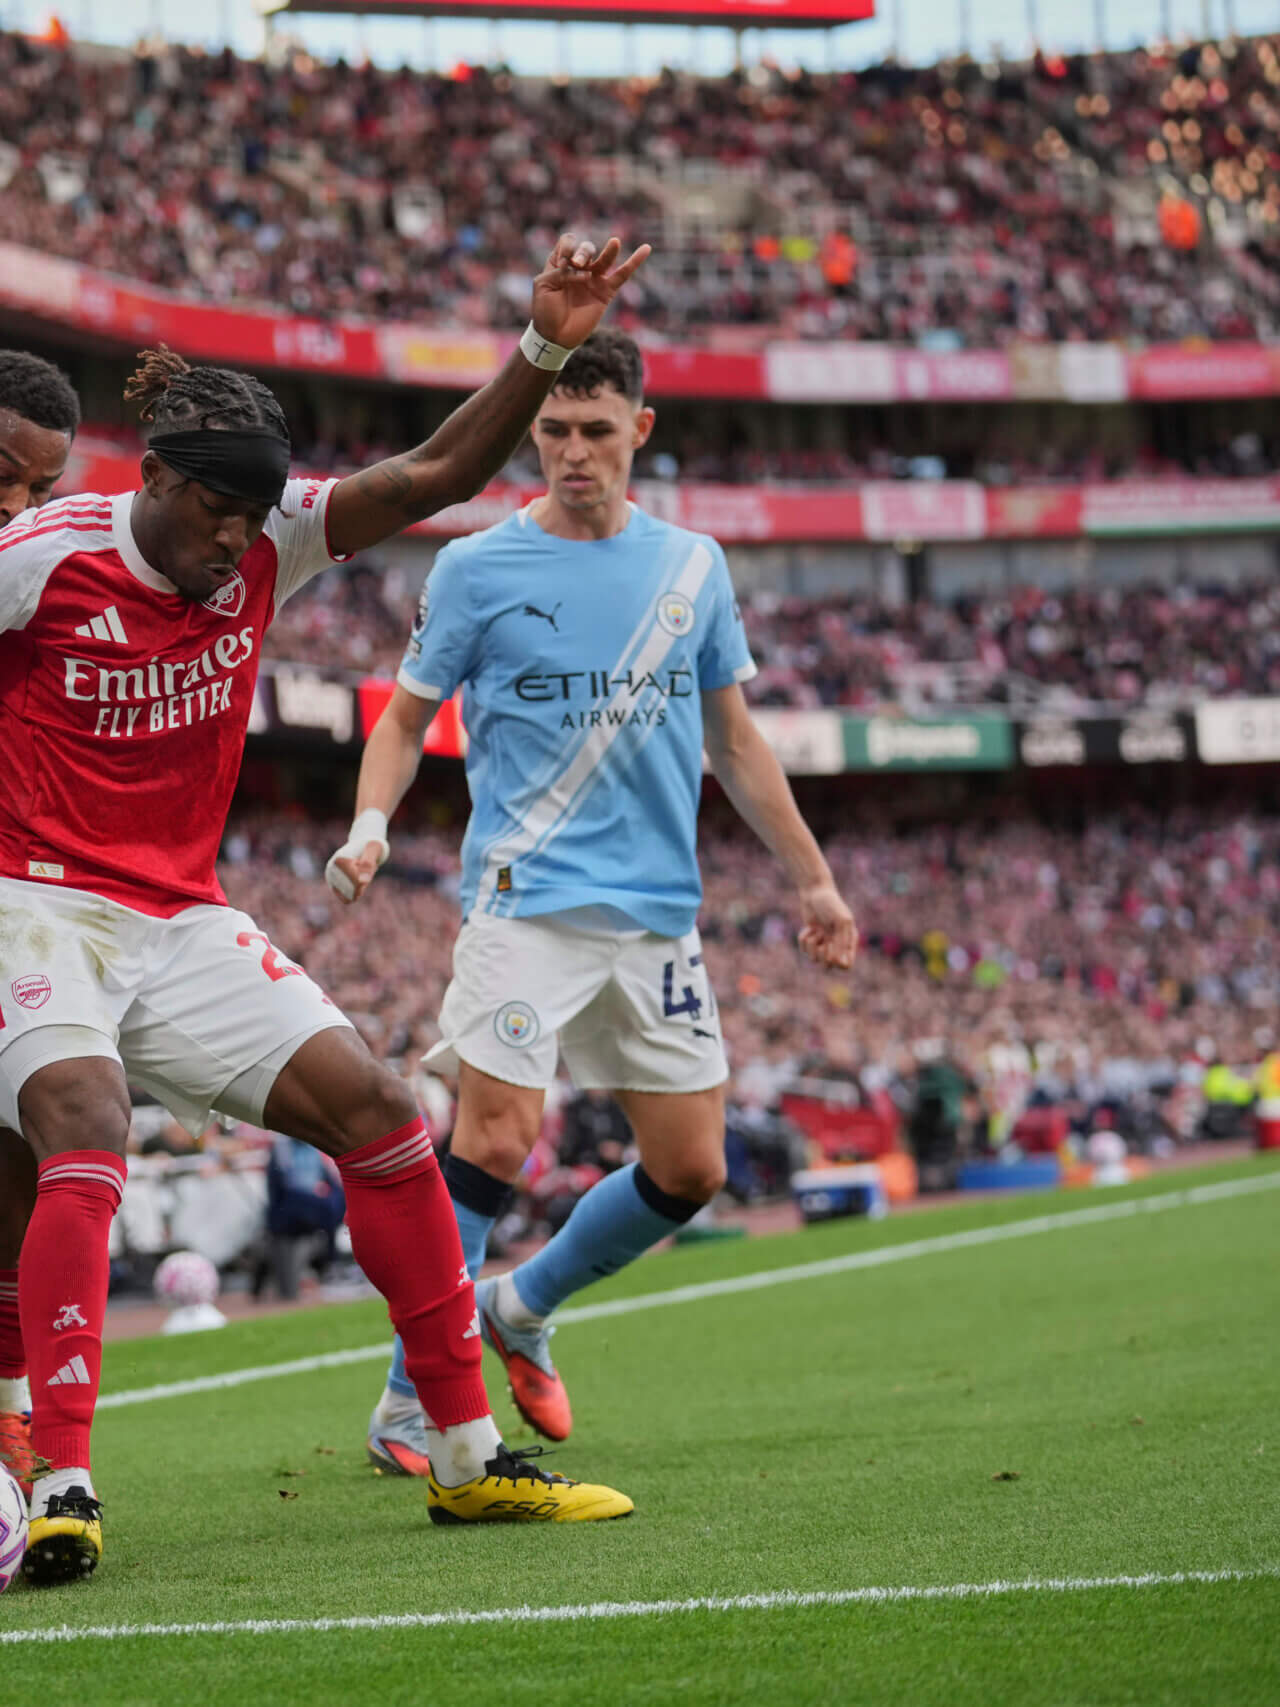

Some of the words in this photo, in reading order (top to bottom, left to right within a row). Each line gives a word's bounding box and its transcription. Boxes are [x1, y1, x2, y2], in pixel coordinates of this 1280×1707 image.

[64, 626, 254, 702] Emirates
[515, 671, 692, 701] ETIHAD
[94, 707, 142, 738] FLY
[149, 676, 234, 733] BETTER
[560, 707, 667, 729] AIRWAYS
[482, 1499, 560, 1518] F50
